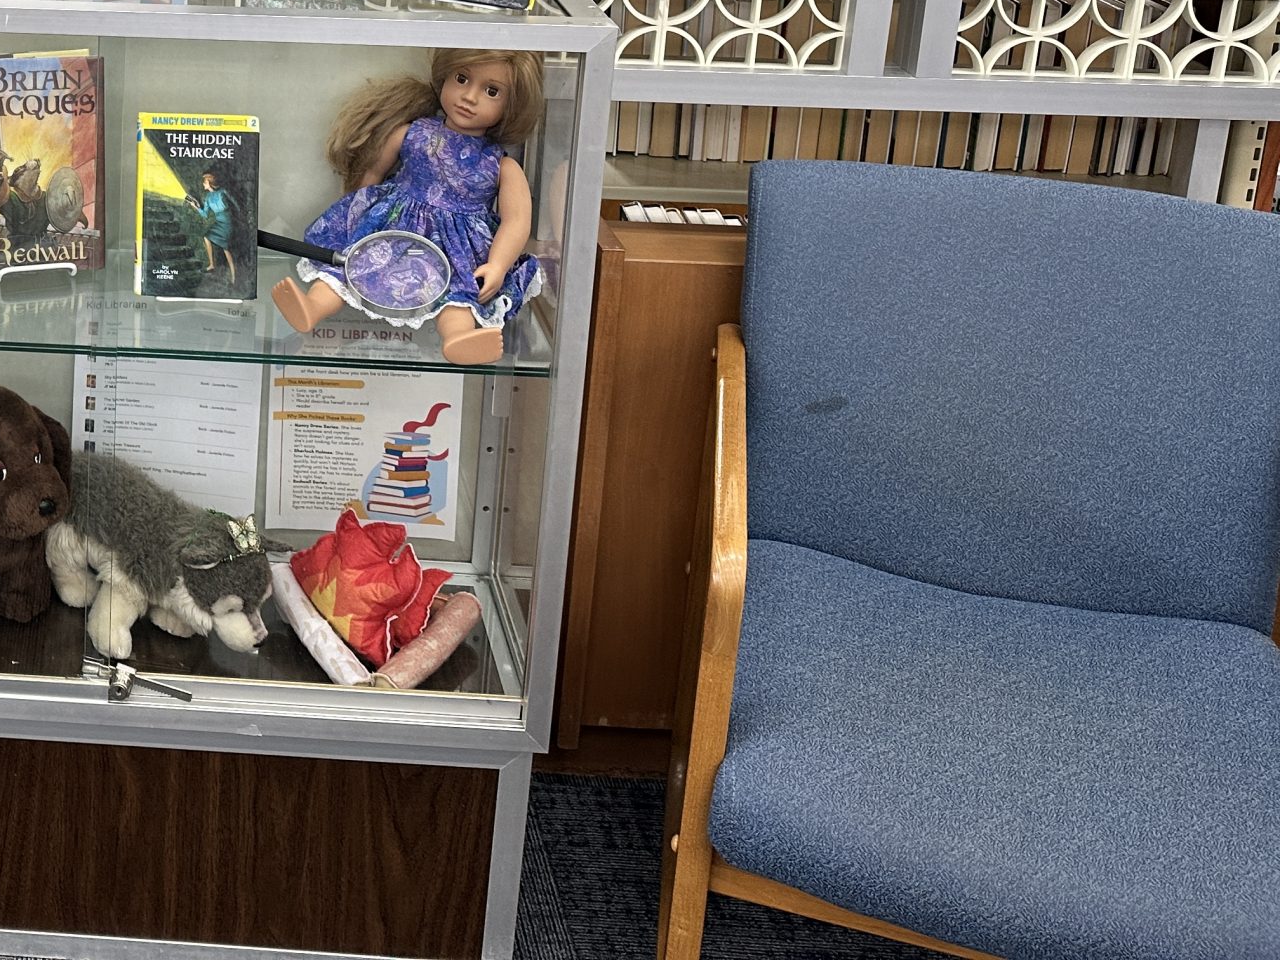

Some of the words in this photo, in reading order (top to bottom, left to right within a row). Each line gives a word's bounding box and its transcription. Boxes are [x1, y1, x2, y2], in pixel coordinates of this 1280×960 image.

[152, 116, 179, 125] NANCY
[180, 117, 205, 126] DREW
[251, 119, 257, 127] 2
[165, 133, 188, 144] THE
[192, 133, 242, 146] HIDDEN
[169, 146, 234, 159] STAIRCASE
[86, 301, 102, 310] Kid
[105, 301, 148, 310] Librarian
[312, 328, 336, 339] KID
[342, 329, 413, 341] LIBRARIAN
